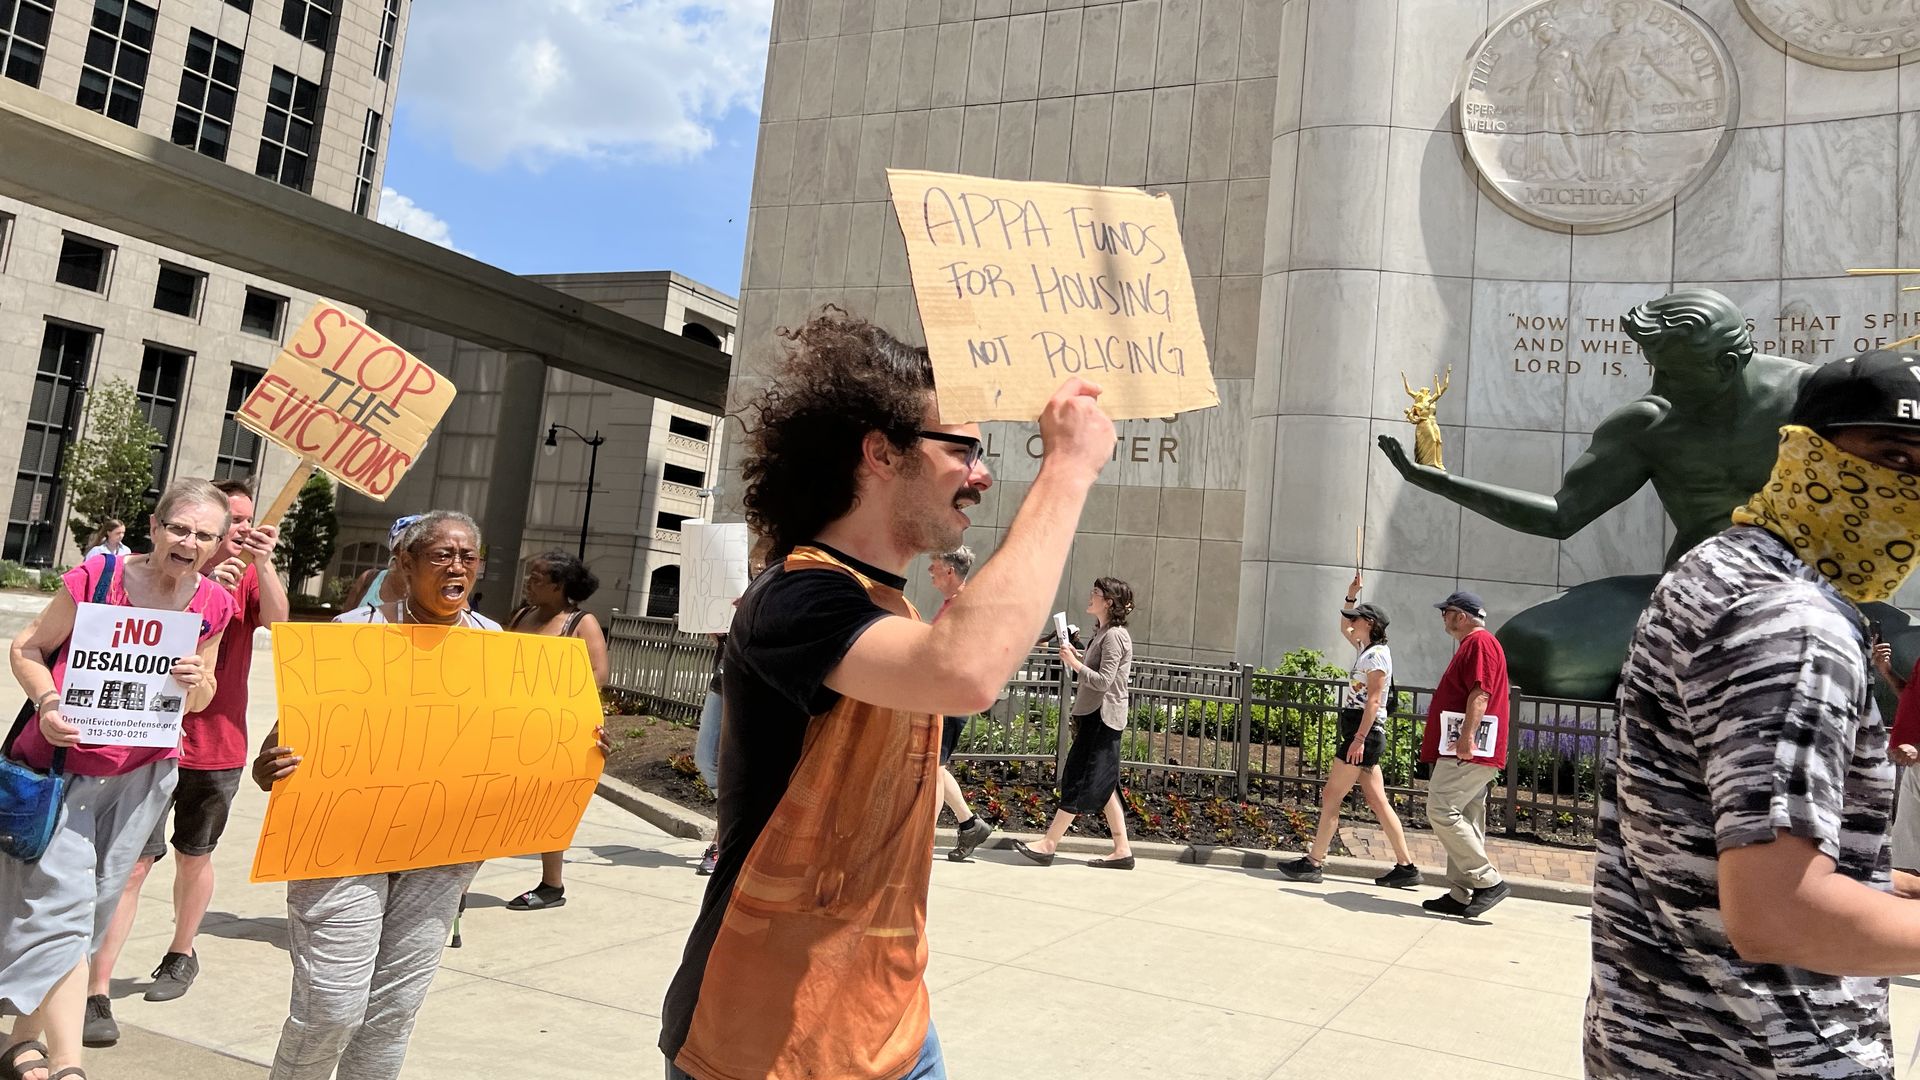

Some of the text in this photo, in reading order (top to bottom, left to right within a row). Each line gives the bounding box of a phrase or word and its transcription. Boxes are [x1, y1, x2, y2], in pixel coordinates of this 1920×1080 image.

[1523, 187, 1648, 206] MICHIGAN
[1063, 206, 1167, 265] FUNDS
[938, 261, 1172, 323] FOR HOUSING
[1513, 336, 1565, 352] AND
[1773, 314, 1841, 333] THAT
[294, 308, 436, 410] STOP
[967, 331, 1185, 379] NOT POLICING
[1514, 358, 1582, 375] LORD
[317, 367, 401, 438] THE
[242, 374, 412, 495] EVICTIONS
[1025, 432, 1179, 464] CTER
[111, 618, 163, 648] ¡NO
[276, 625, 588, 698] RESPECT AND
[62, 715, 177, 730] DetroitEvictionDefense.org
[87, 729, 148, 739] 313-530-0216
[283, 704, 579, 779] DIGNITY FOR
[255, 772, 597, 879] EVICTED TENANTS
